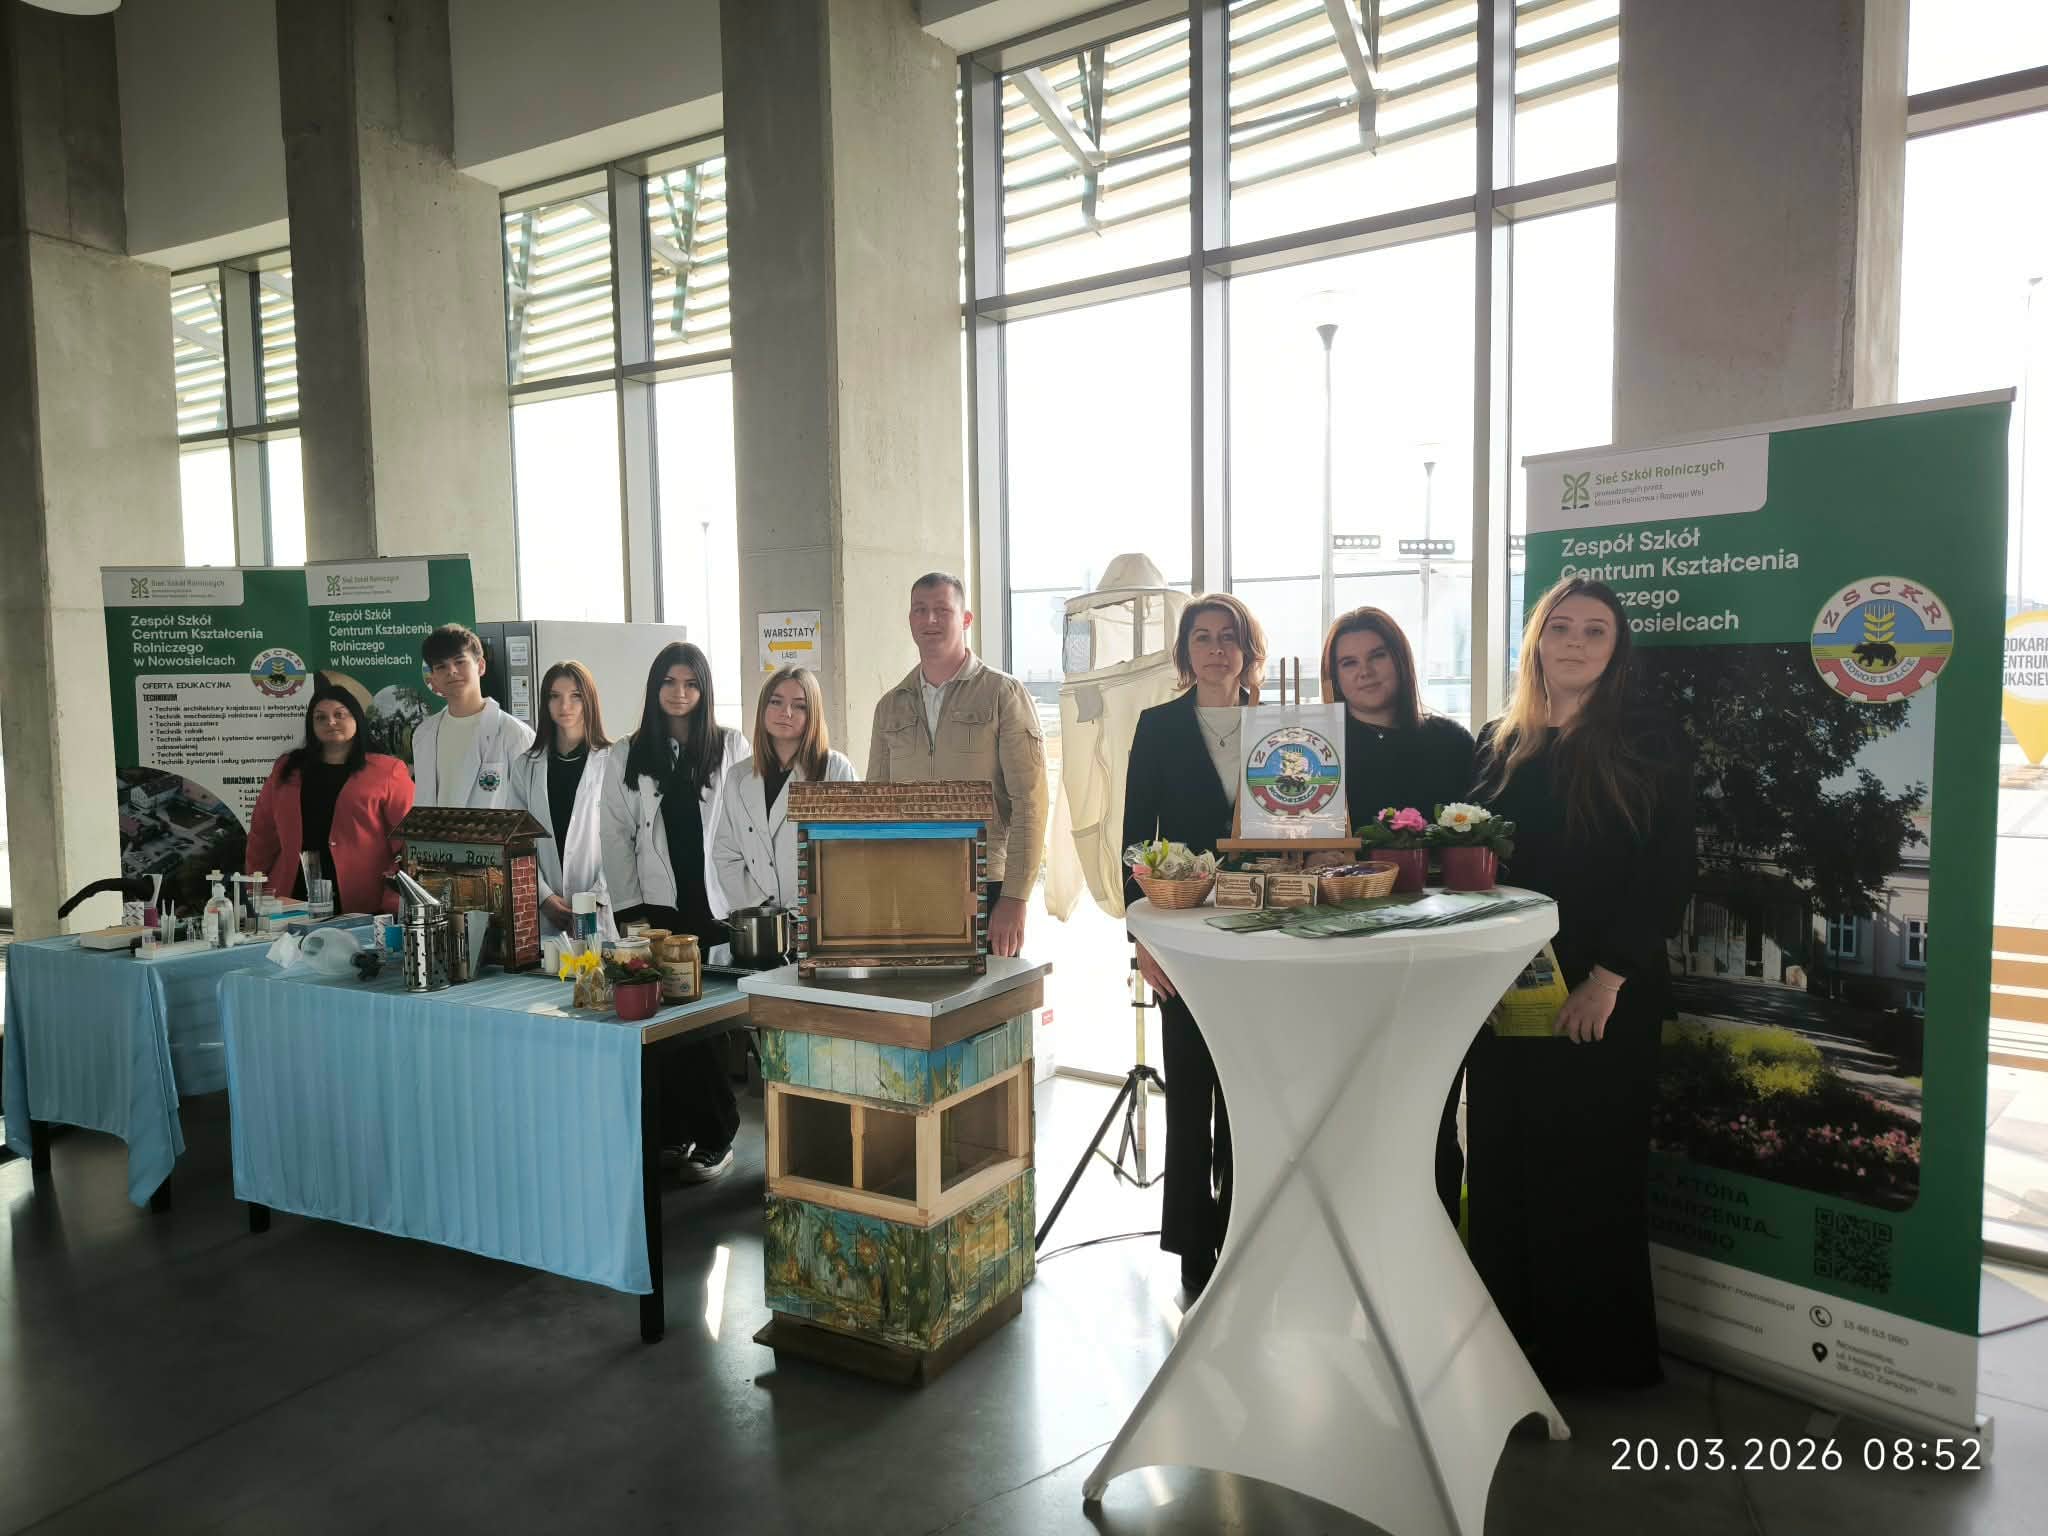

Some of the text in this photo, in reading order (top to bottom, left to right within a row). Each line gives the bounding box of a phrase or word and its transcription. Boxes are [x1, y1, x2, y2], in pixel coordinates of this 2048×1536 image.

[1594, 459, 1725, 486] Sieć Szkół Rolniczych
[1561, 528, 1701, 560] Zespół Szkół
[1561, 547, 1799, 581] Centrum Kształcenia
[1615, 588, 1680, 609] czego
[1821, 581, 1942, 629] ZSCKR
[130, 614, 212, 629] Zespół Szkół
[328, 608, 392, 623] Zespół Szkół
[1628, 609, 1740, 633] osielcach
[132, 627, 264, 640] Centrum Kształcenia
[329, 622, 433, 637] Centrum Kształcenia
[763, 627, 815, 638] WARSZTATY
[133, 641, 204, 655] Rolniczego
[330, 640, 385, 653] Rolniczego
[134, 655, 236, 667] w Nowosielcach
[331, 653, 412, 666] w Nowosielcach
[142, 681, 231, 690] OFERTA EDUKACYJNA
[1254, 731, 1332, 764] ZSCKR
